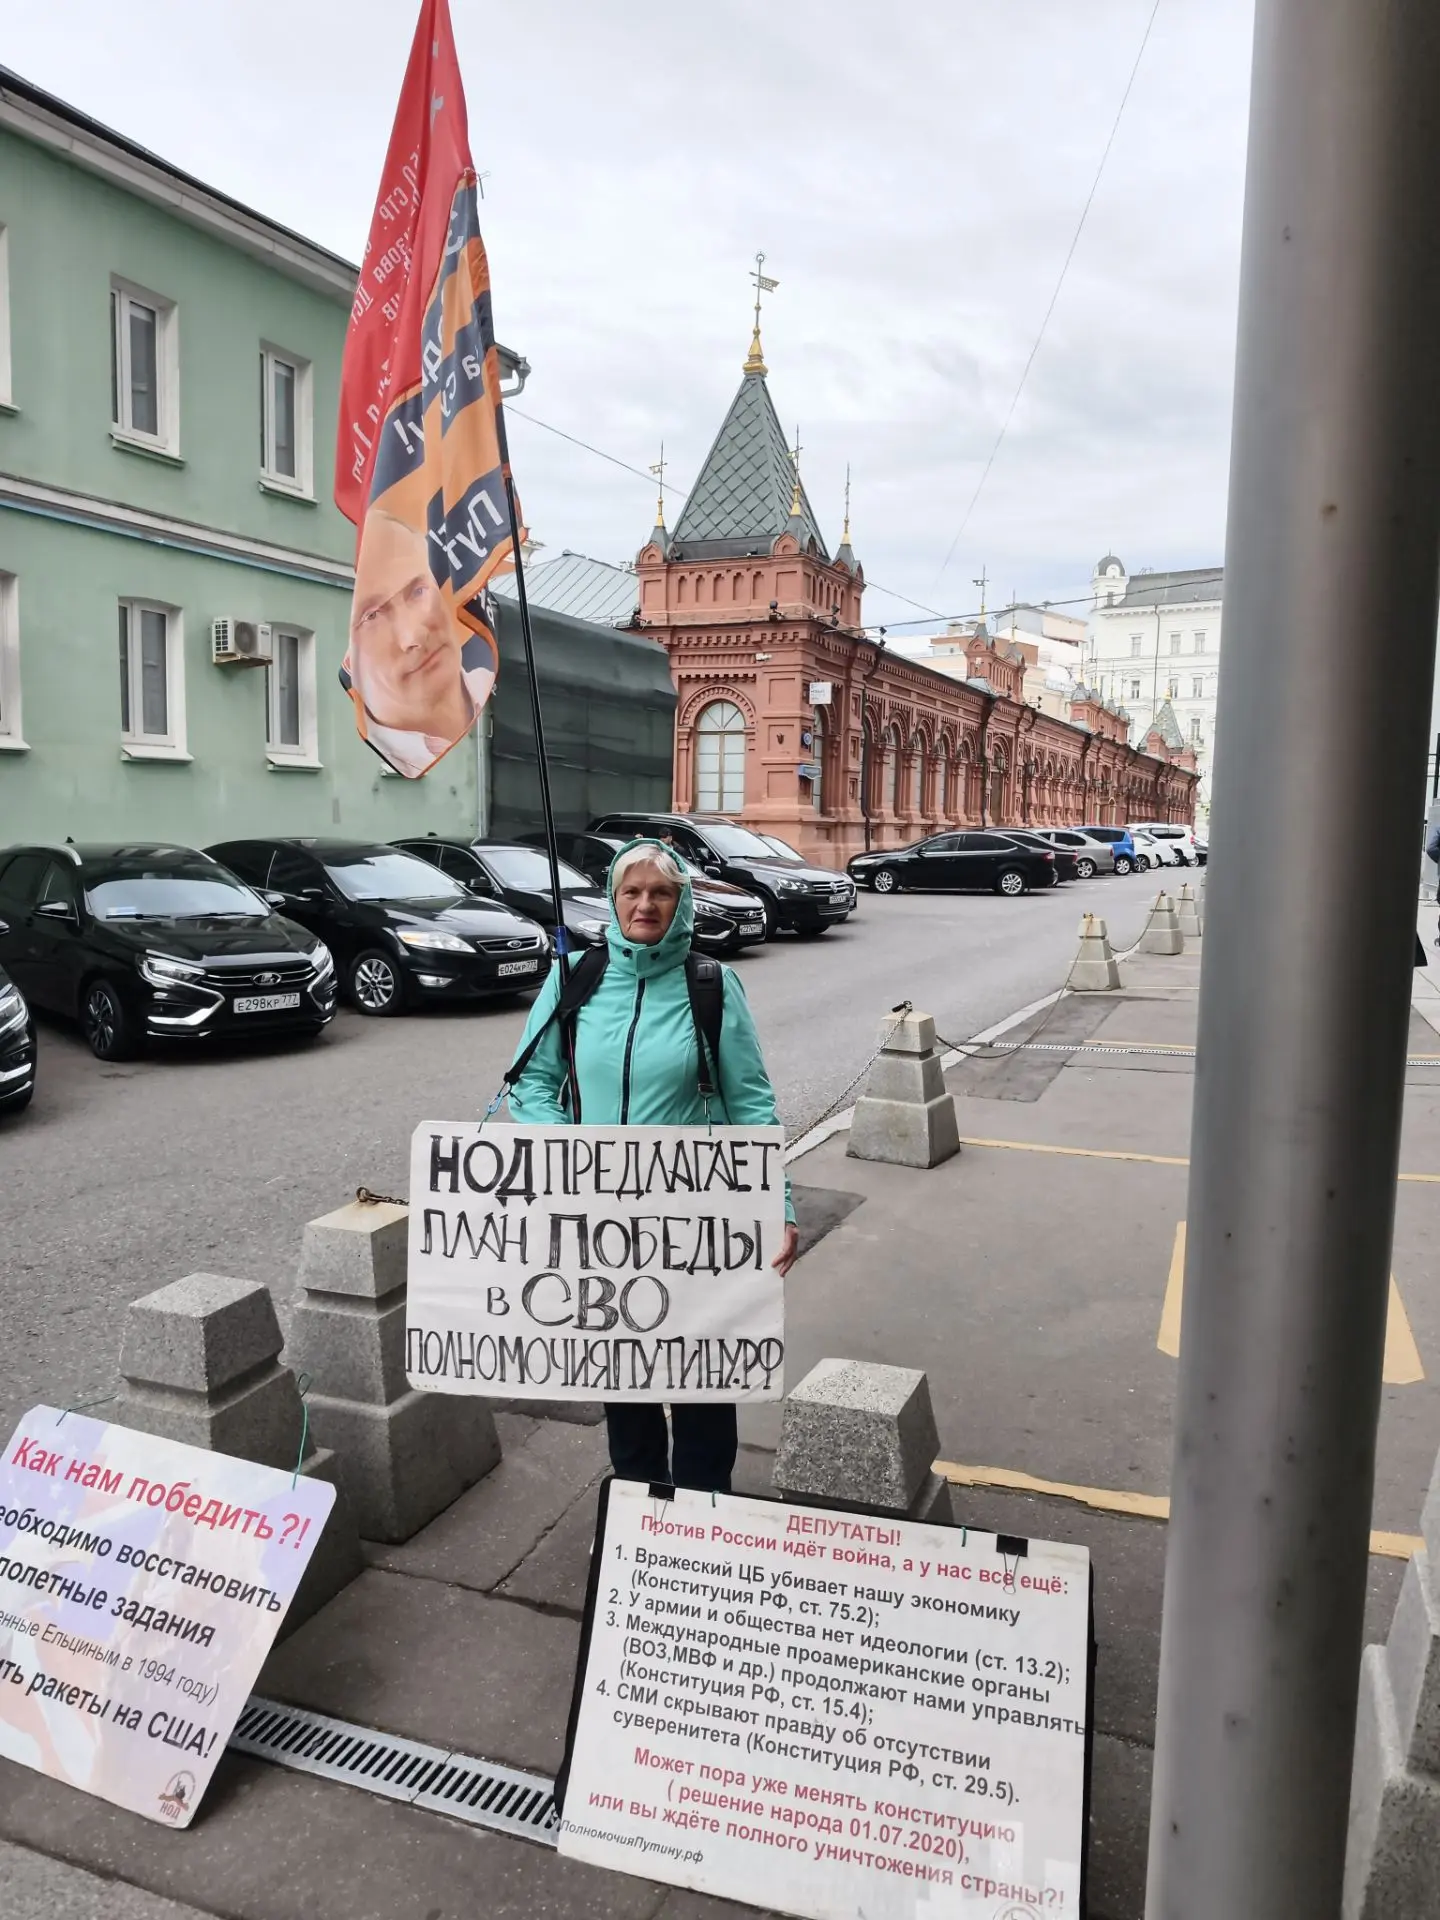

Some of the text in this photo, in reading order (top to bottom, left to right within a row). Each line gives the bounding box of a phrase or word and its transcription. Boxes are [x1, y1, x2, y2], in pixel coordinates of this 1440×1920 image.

[237, 997, 280, 1012] Е298КР
[429, 1134, 781, 1207] НОД ПРЕДЛАГАЕТ
[419, 1208, 764, 1277] ПЛАН ПОБЕДЫ
[521, 1272, 671, 1333] СВО
[11, 1436, 311, 1549] Как нам победить?!
[785, 1513, 900, 1546] ДЕПУТАТЫ!
[115, 1543, 281, 1612] восстановить
[615, 1544, 1020, 1626] 1. Вражеский ЦБ убивает нашу экономику
[640, 1514, 1067, 1595] Против России идёт война, а у нас всё ещё:
[110, 1596, 216, 1647] задания
[607, 1587, 1069, 1684] 2. У армии и общества нет идеологии (ст. 13.2);
[631, 1568, 879, 1628] (Конституция РФ, ст. 75.2);
[40, 1622, 121, 1667] Ельциным
[120, 1655, 133, 1671] в
[137, 1657, 176, 1686] 1994
[175, 1675, 219, 1705] году)
[605, 1609, 1049, 1703] 3. Международные проамериканские органы
[619, 1658, 873, 1725] (Конституция РФ, ст. 15.4);
[722, 1657, 733, 1672] и
[737, 1660, 774, 1683] др.)
[781, 1668, 907, 1702] продолжают
[913, 1691, 965, 1713] нами
[971, 1702, 1084, 1735] управлять
[24, 1671, 111, 1718] ракеты
[111, 1703, 143, 1730] на
[147, 1711, 218, 1758] США!
[595, 1678, 990, 1770] 4. СМИ скрывают правду об отсутствии
[612, 1710, 1019, 1804] суверенитета (Конституция РФ, ст. 29.5).
[633, 1746, 1015, 1842] Может пора уже менять конституцию
[588, 1791, 624, 1812] или
[629, 1800, 657, 1819] вы
[660, 1807, 720, 1833] ждёте
[725, 1821, 808, 1852] полного
[812, 1840, 953, 1885] уничтожения
[960, 1873, 1064, 1910] страны?!
[677, 1785, 764, 1816] решение
[769, 1804, 842, 1835] народа
[849, 1817, 969, 1864] 01.07.2020),
